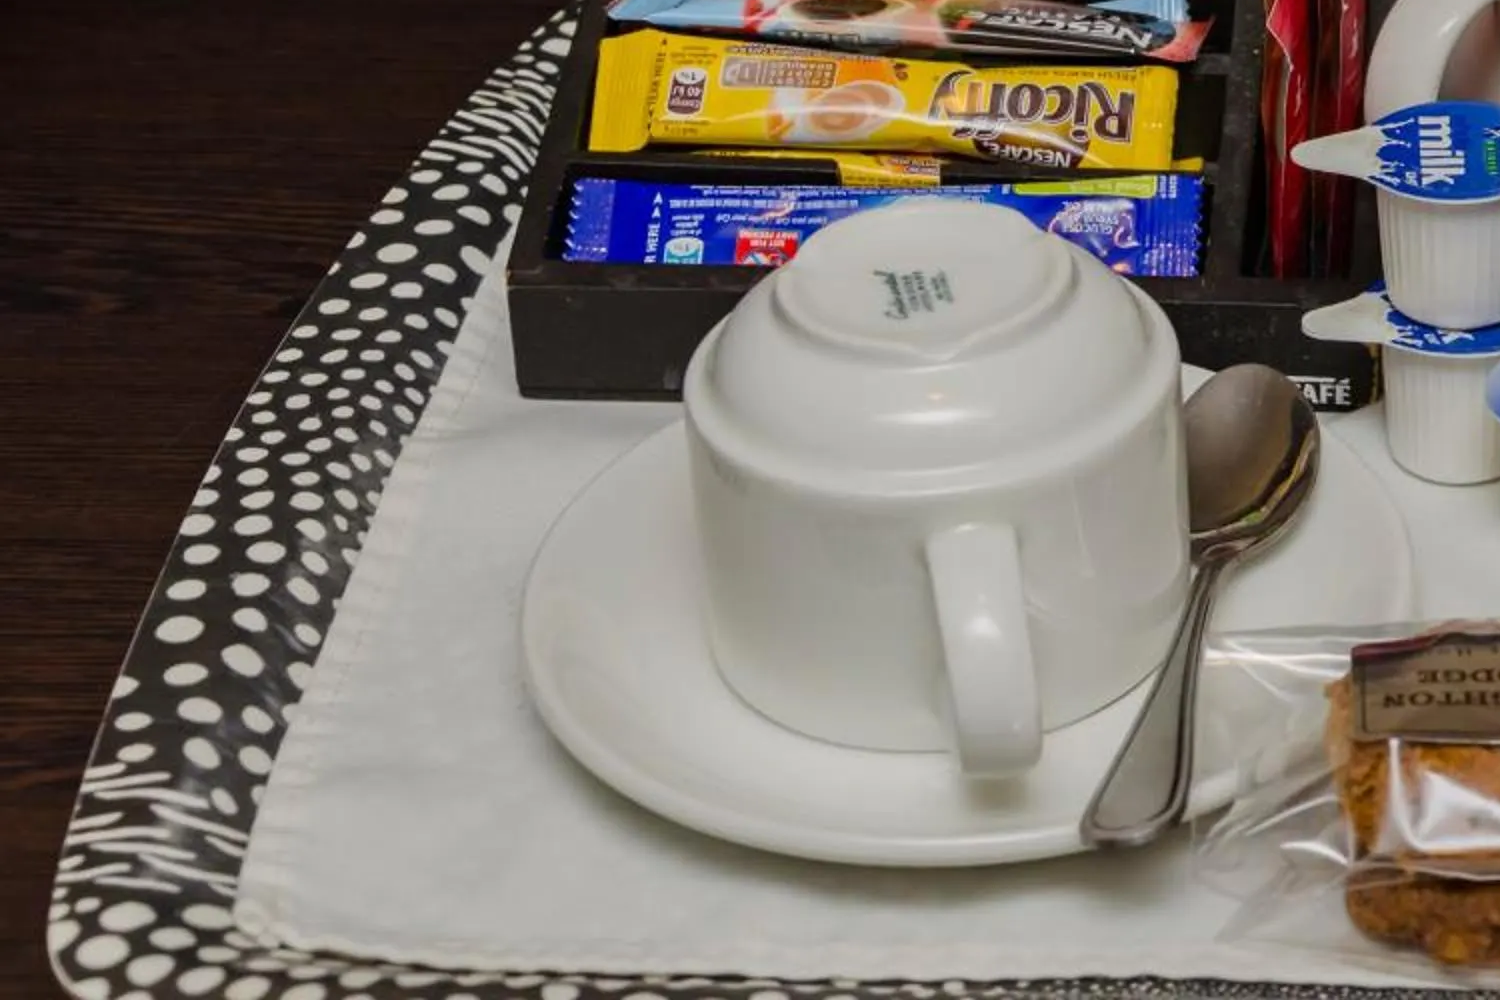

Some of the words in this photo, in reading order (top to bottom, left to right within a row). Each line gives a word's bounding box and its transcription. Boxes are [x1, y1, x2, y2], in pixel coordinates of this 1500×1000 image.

[928, 69, 1136, 145] Ricoffy
[1417, 115, 1467, 187] milk
[1296, 377, 1351, 405] AFÉ
